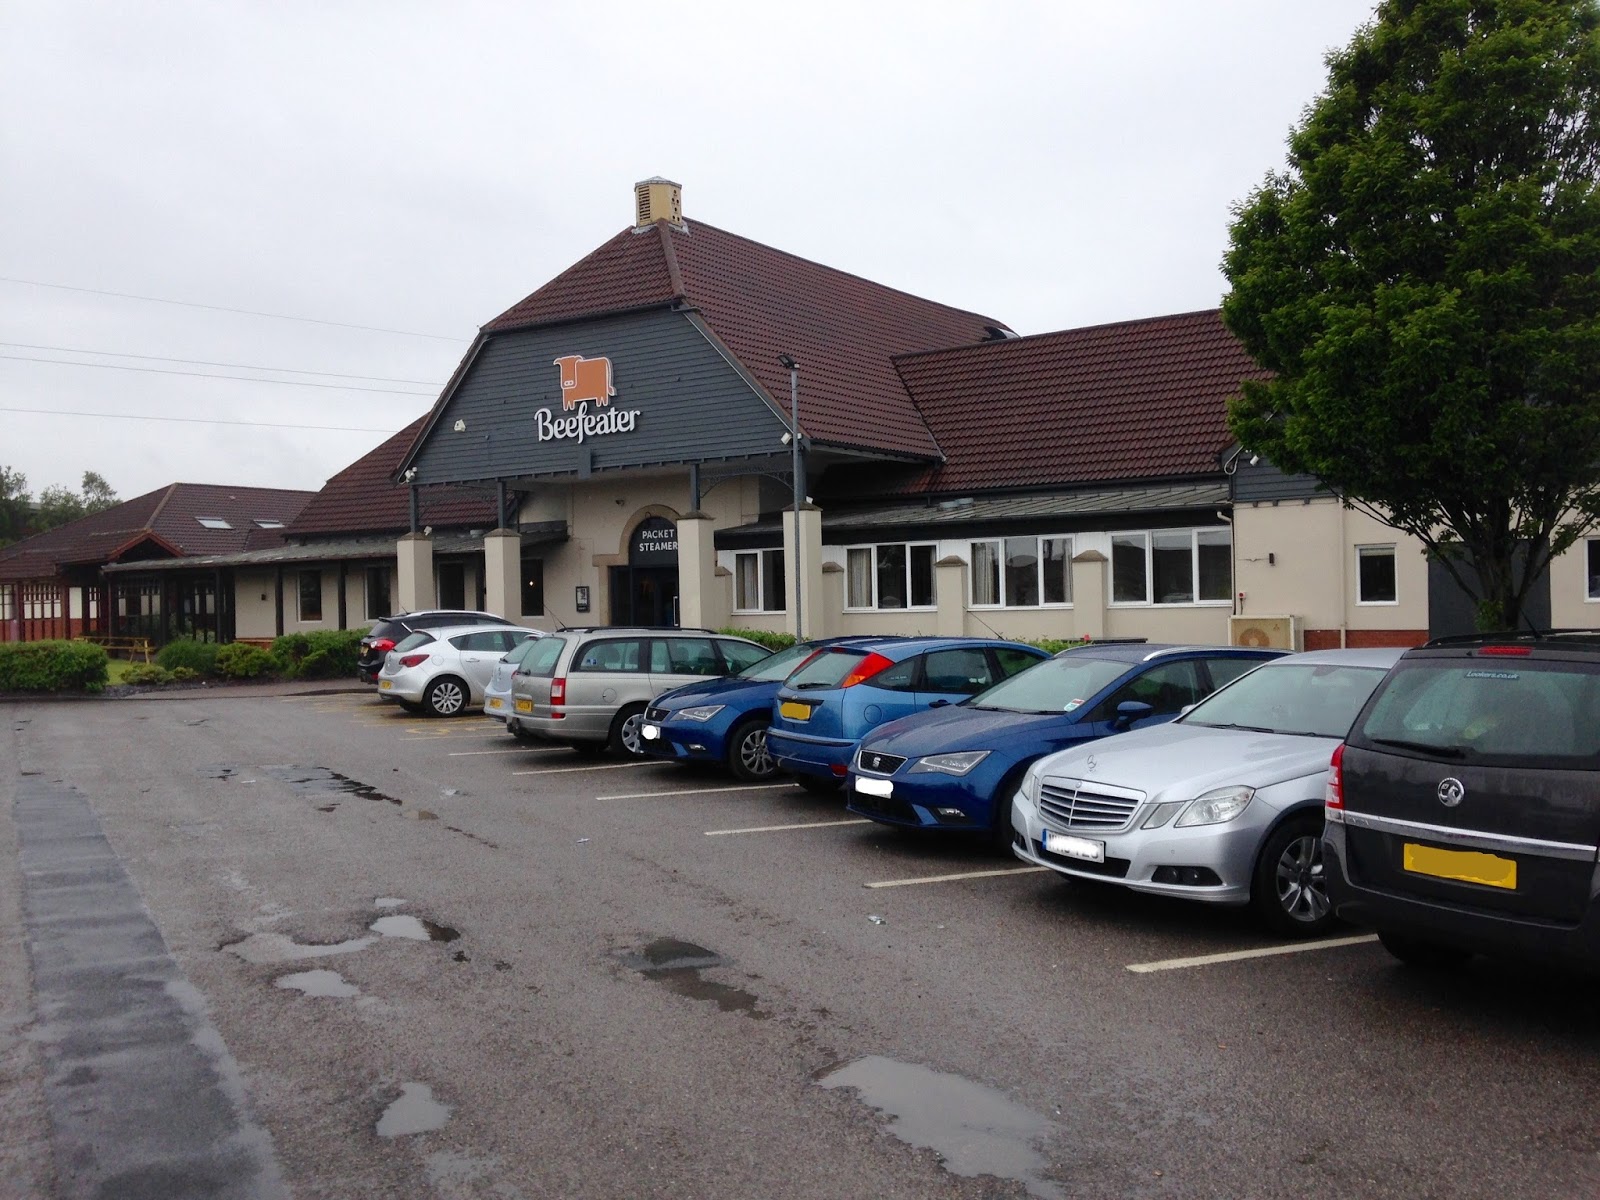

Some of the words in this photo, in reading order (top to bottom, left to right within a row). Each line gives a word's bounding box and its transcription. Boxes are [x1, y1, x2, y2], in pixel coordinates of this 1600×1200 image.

[534, 401, 641, 444] Beefeater
[642, 529, 675, 539] PACKET
[639, 541, 678, 552] STEAMER
